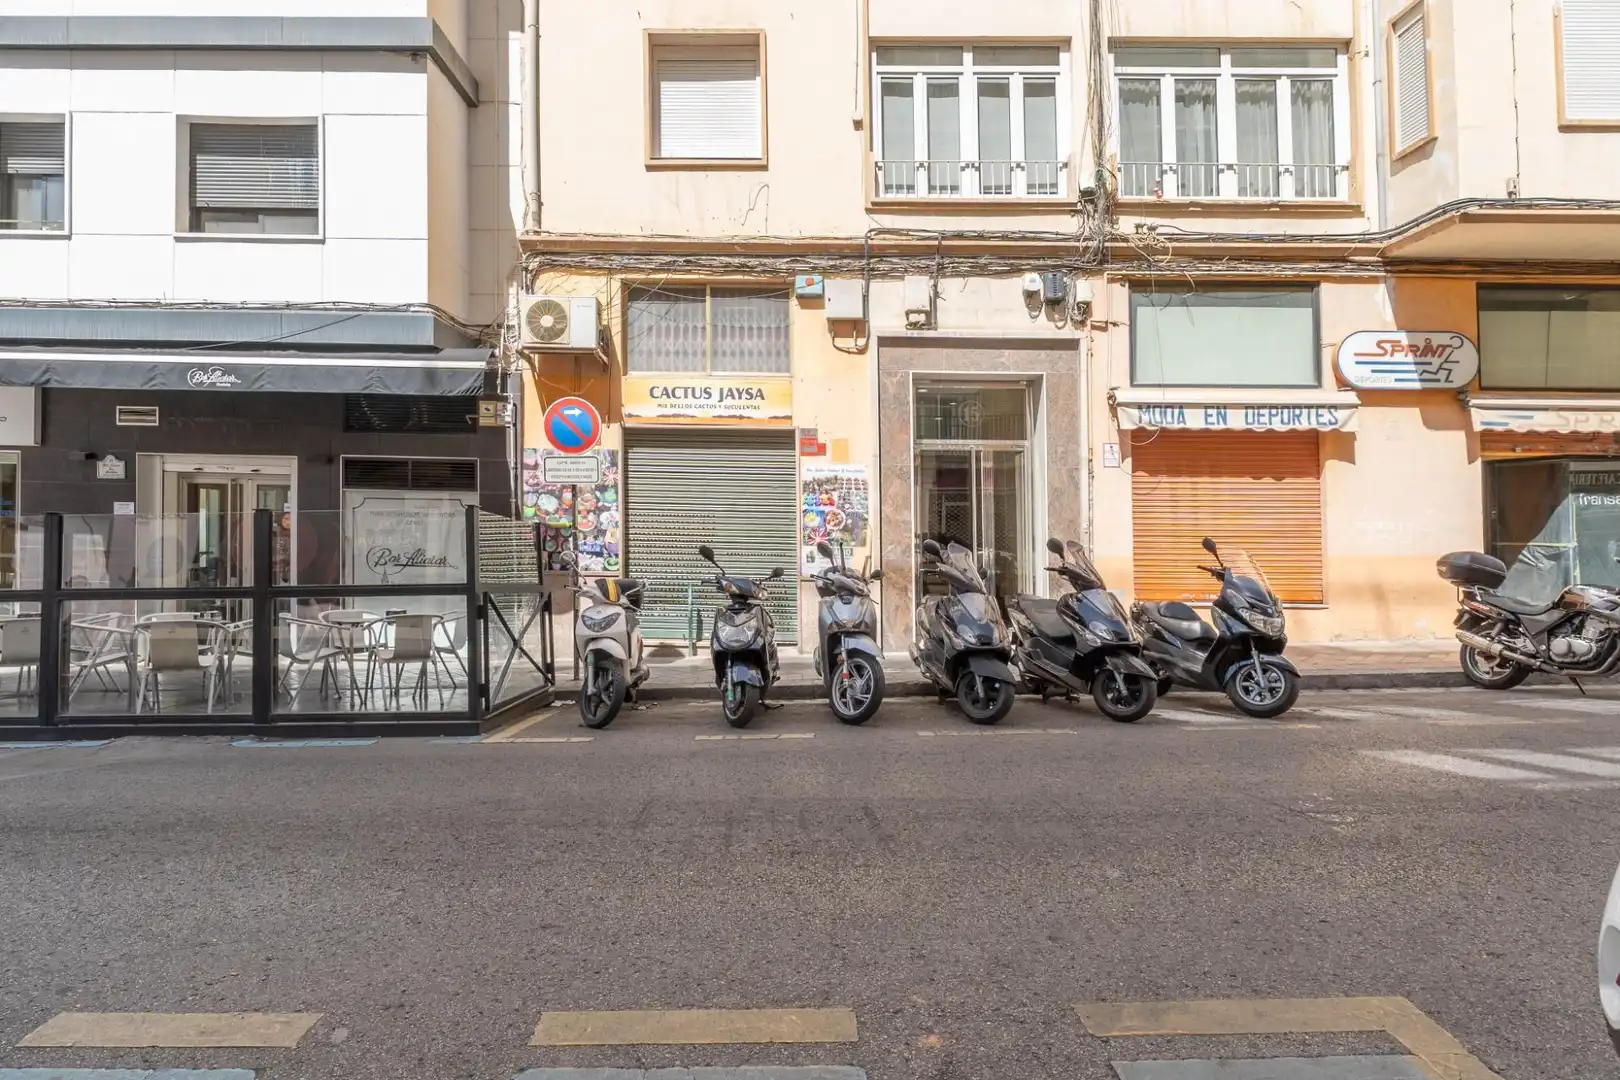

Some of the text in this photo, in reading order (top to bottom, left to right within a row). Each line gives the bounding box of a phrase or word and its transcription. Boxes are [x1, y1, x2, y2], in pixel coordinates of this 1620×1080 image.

[1354, 339, 1453, 358] SPRINT
[649, 386, 766, 402] CACTUS JAYSA
[963, 406, 980, 421] 15
[1138, 405, 1339, 427] MODA EN DEPORTES
[369, 547, 402, 569] Bar
